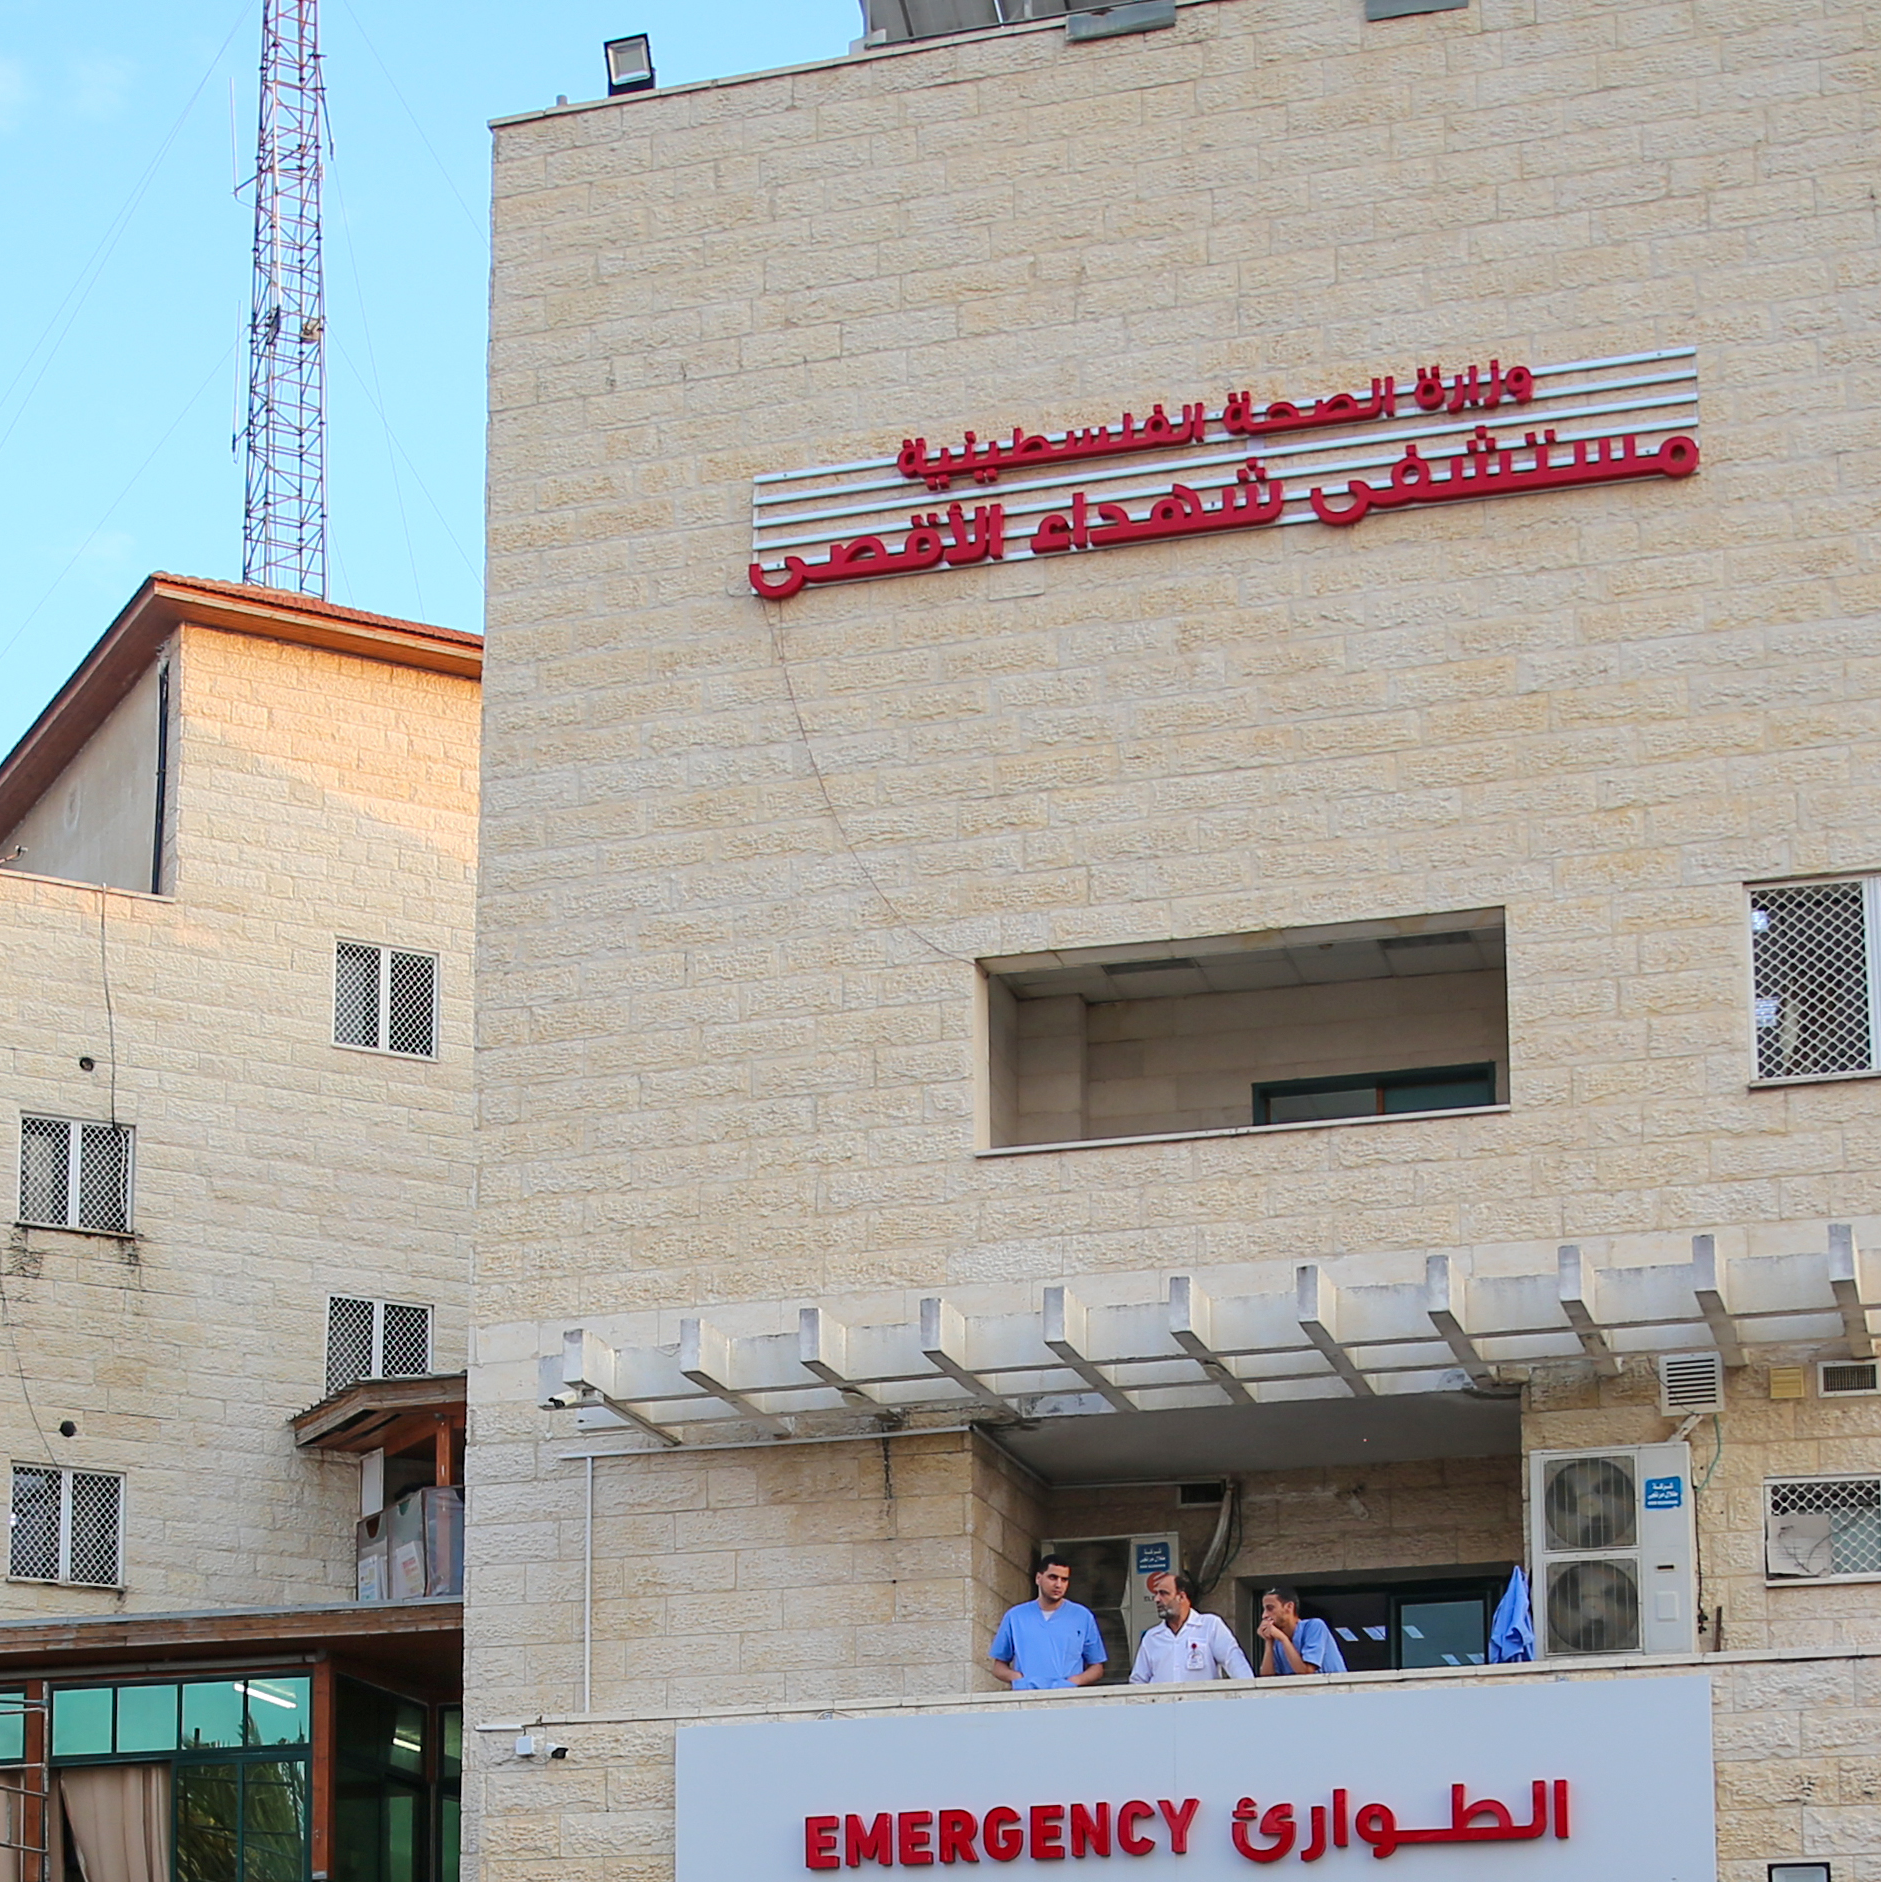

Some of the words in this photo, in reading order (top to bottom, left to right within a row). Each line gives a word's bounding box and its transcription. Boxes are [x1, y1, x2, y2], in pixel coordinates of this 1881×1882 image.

[1221, 376, 1397, 434] الصحة
[1413, 359, 1535, 415] وزارة
[897, 402, 1206, 490] الفلسطينية
[1310, 425, 1699, 525] مستشفى
[1030, 457, 1285, 553] شهداء
[749, 500, 1007, 598] الأقصى
[806, 1798, 1201, 1869] EMERGENCY
[1231, 1778, 1571, 1864] الطوارئ
